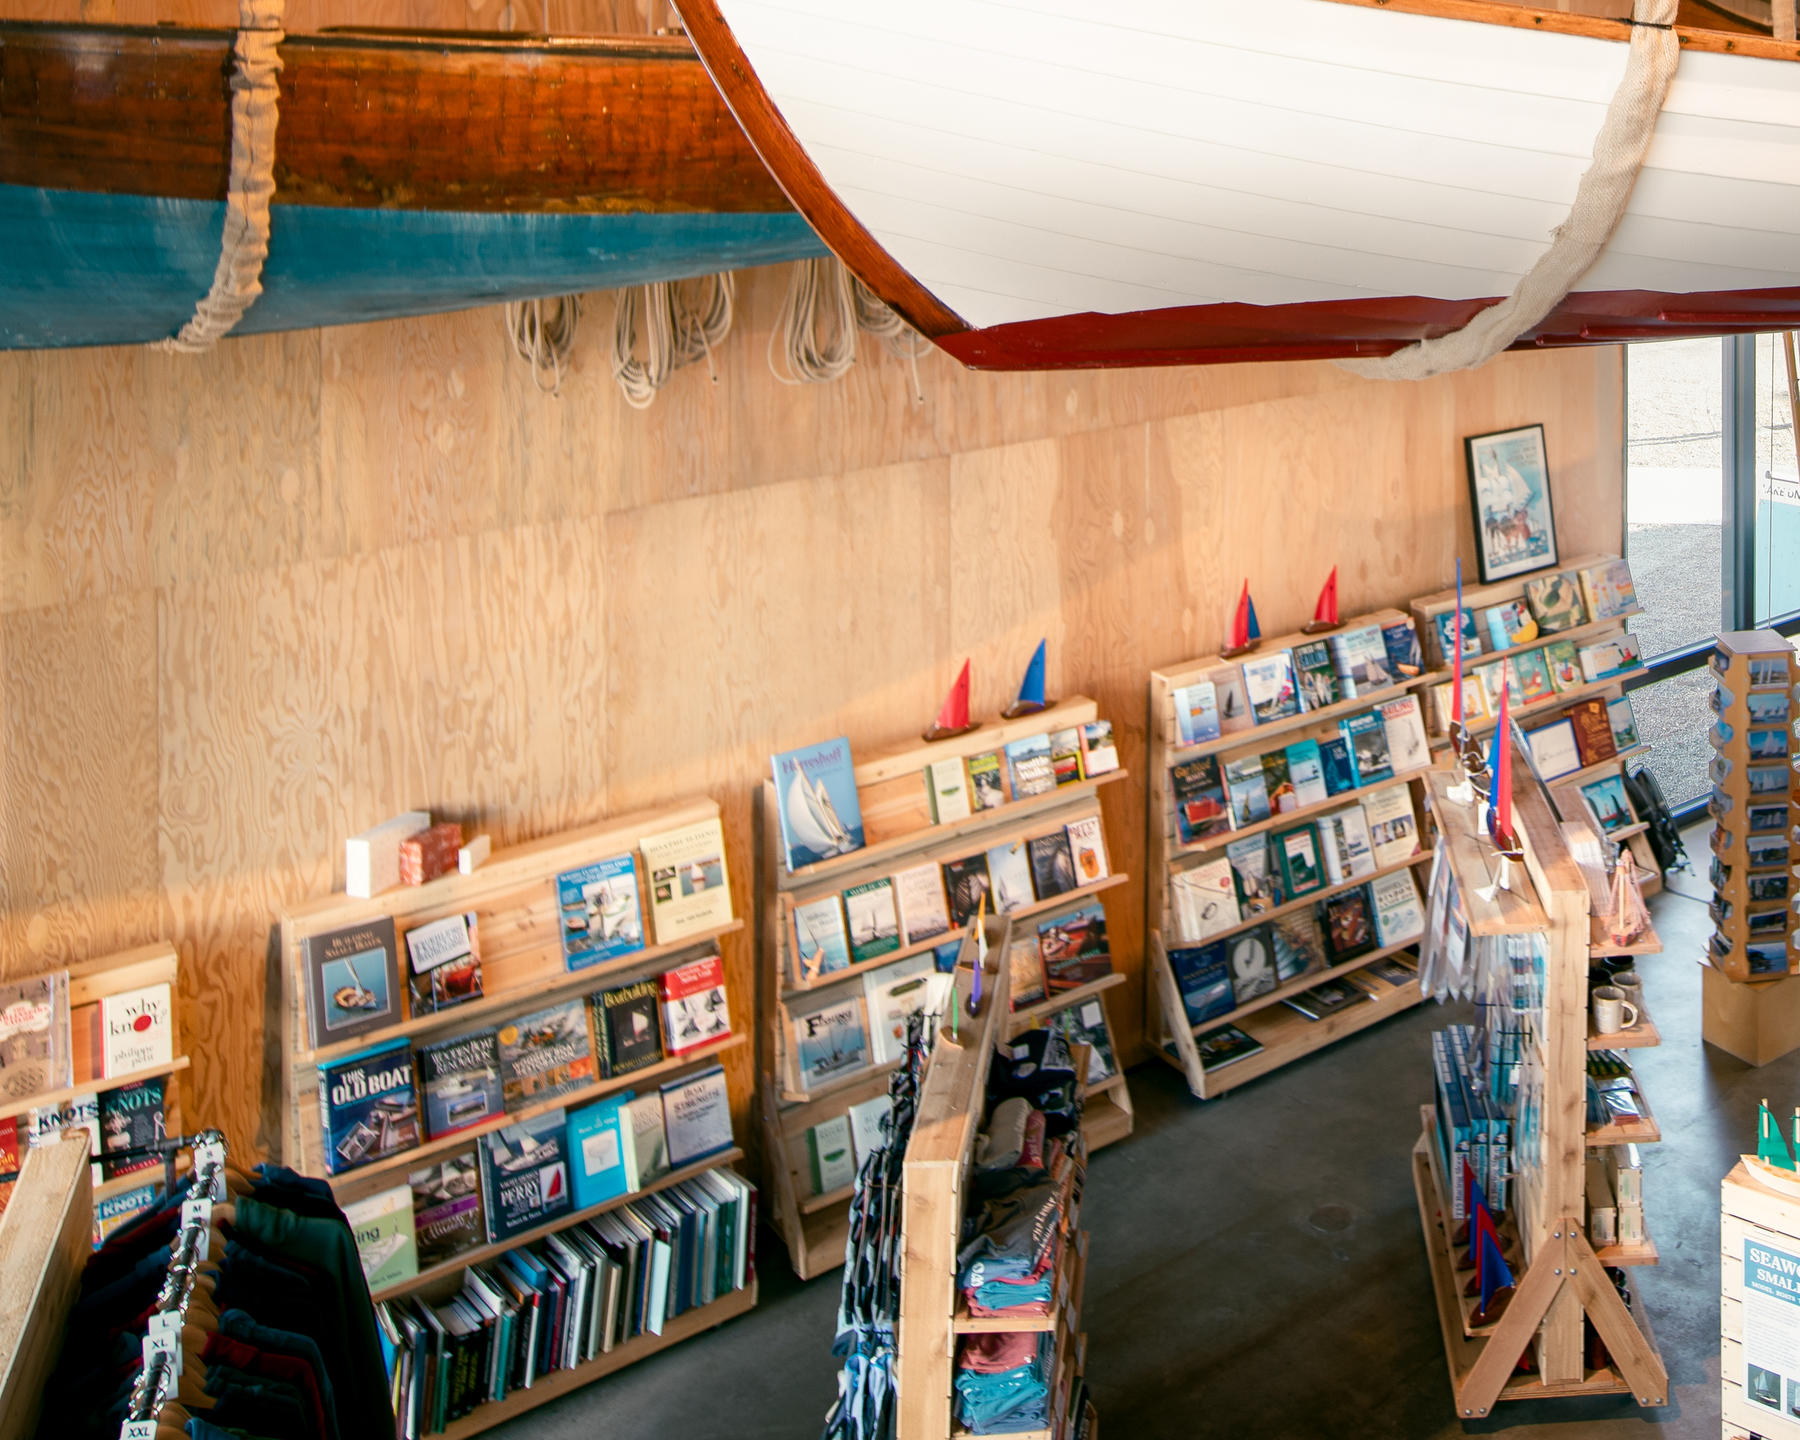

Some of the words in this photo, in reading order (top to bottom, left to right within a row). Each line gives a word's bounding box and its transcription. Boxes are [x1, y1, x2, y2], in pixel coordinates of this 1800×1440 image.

[125, 998, 160, 1017] why
[332, 1080, 366, 1106] OLD
[368, 1065, 413, 1093] BOAT
[340, 1068, 366, 1086] THIS
[105, 1087, 162, 1116] KNOTS
[38, 1101, 99, 1131] KNOTS
[102, 1189, 153, 1217] KNOTS
[501, 1181, 540, 1207] PERRY
[193, 1204, 202, 1215] M
[354, 1225, 380, 1244] ing
[1752, 1281, 1775, 1295] MODEL
[1776, 1290, 1796, 1303] BOATS
[162, 1317, 169, 1328] L
[151, 1337, 168, 1349] XL
[128, 1426, 150, 1438] XXL
